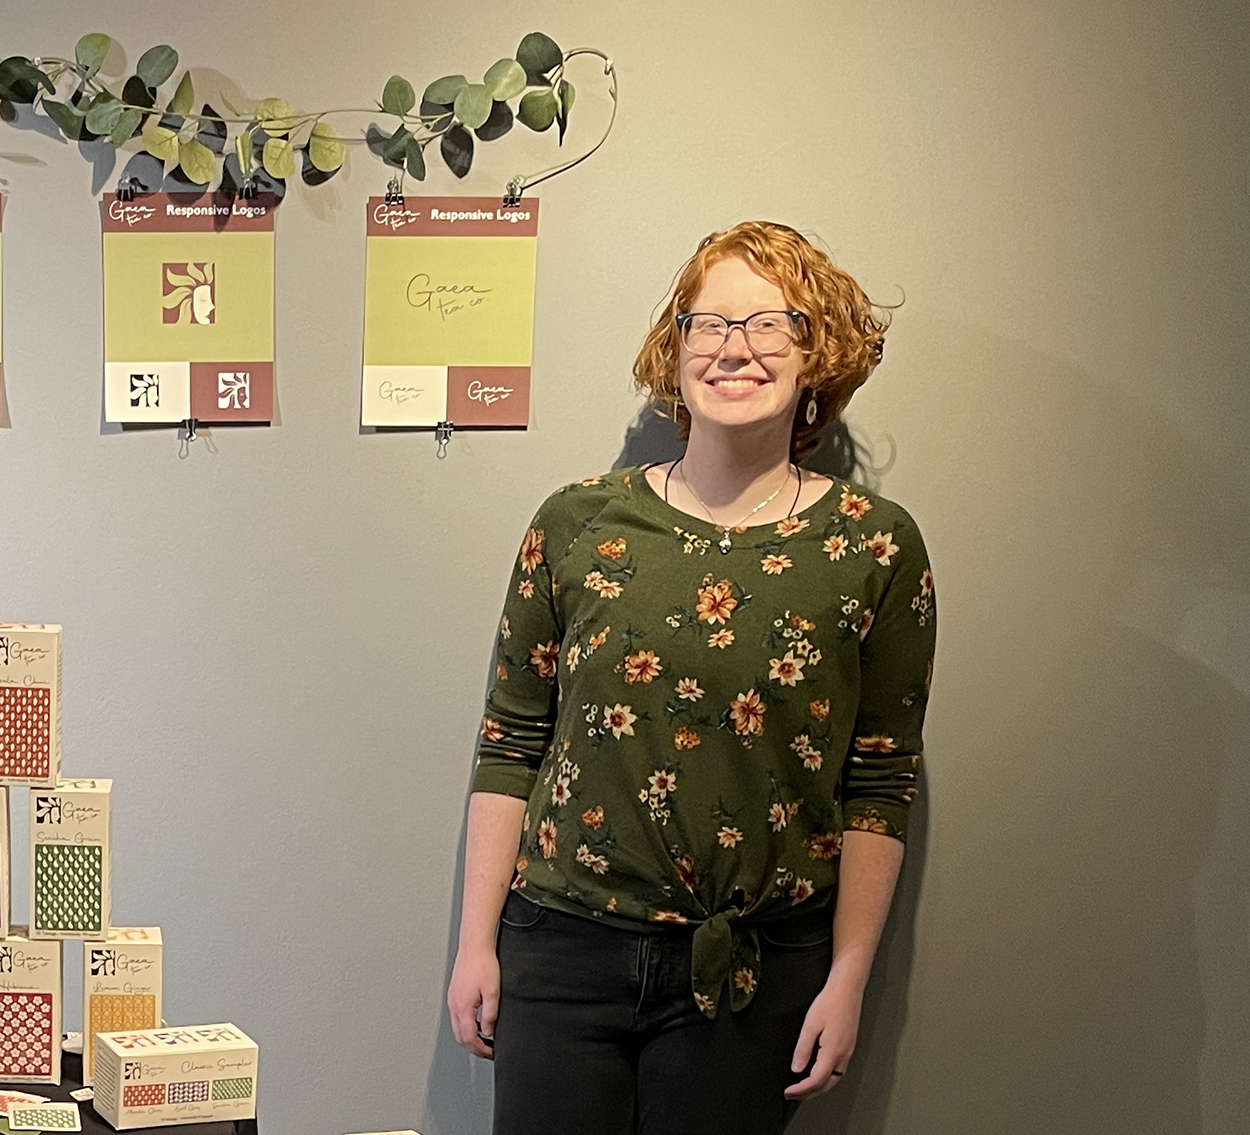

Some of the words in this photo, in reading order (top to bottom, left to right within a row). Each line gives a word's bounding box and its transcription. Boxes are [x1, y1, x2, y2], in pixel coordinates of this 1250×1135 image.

[166, 204, 229, 219] Responsive
[232, 204, 266, 218] Logos
[430, 208, 494, 223] Responsive
[496, 209, 531, 224] Logos
[406, 273, 493, 312] Gaea
[436, 298, 464, 321] tea
